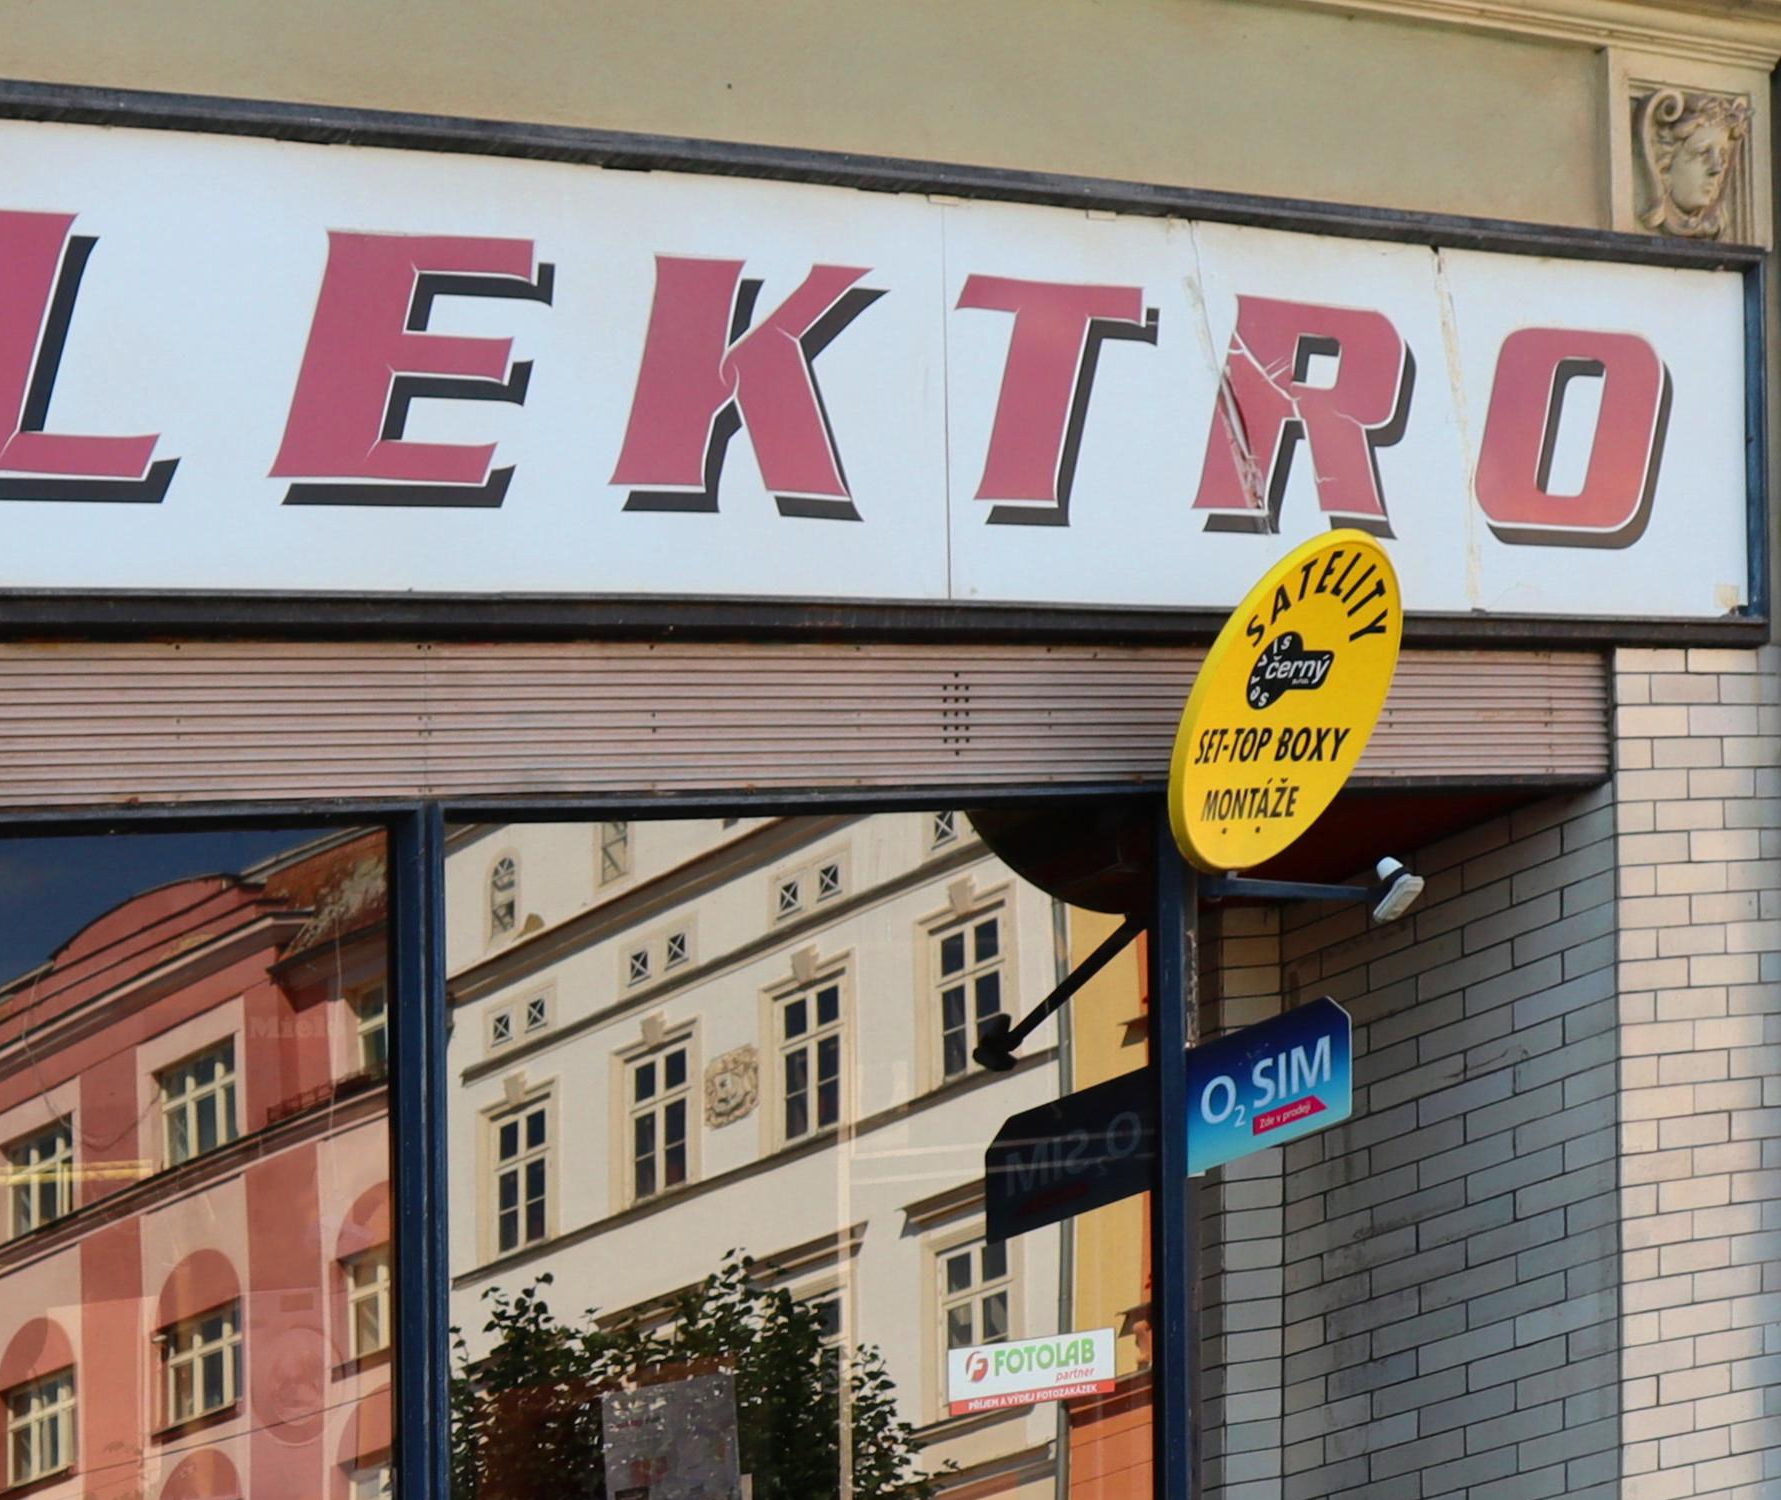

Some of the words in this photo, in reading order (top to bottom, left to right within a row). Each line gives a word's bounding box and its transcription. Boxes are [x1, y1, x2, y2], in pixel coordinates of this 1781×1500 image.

[1246, 550, 1388, 647] SATELITY
[1264, 653, 1331, 684] černý
[1194, 727, 1273, 764] SET-TOP
[1274, 727, 1351, 762] BOXY
[1200, 777, 1300, 822] MONTÁŽE
[1251, 1035, 1332, 1109] SIM
[1259, 1116, 1275, 1129] Zde
[1282, 1102, 1312, 1123] prodeji
[994, 1338, 1095, 1377] FOTOLAB
[1055, 1367, 1095, 1383] partner
